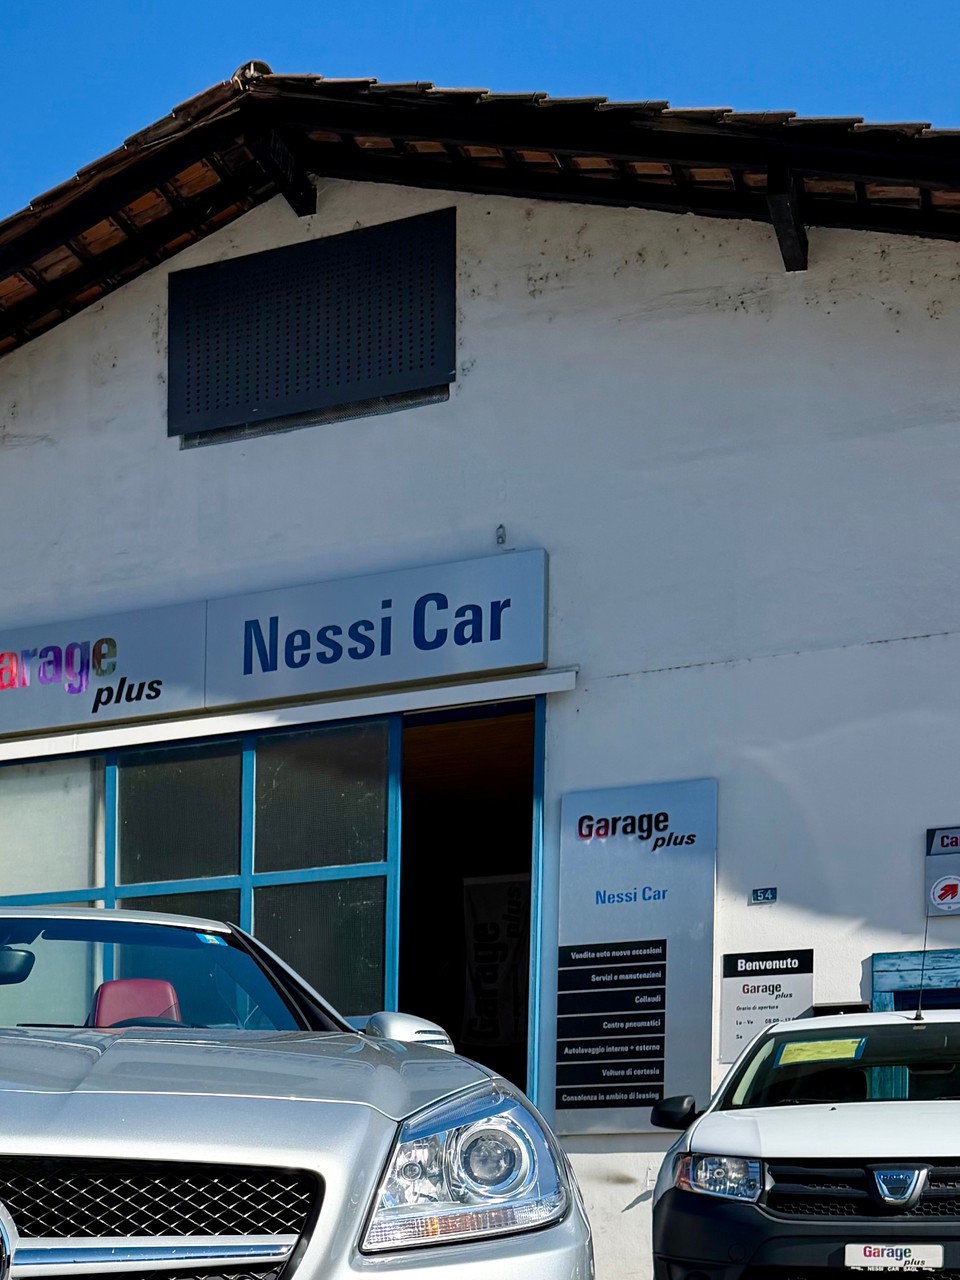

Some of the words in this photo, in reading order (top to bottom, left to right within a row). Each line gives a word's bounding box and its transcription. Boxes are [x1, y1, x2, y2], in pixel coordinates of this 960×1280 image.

[243, 600, 393, 676] Nessi
[412, 592, 512, 651] Car
[91, 675, 163, 713] plus
[577, 811, 670, 841] Garage
[651, 831, 697, 852] plus
[940, 834, 960, 848] Ca
[595, 887, 638, 905] Nessi
[642, 886, 669, 901] Car
[757, 889, 772, 900] 54
[737, 958, 799, 971] Benvenuto
[742, 983, 782, 995] Garage
[775, 992, 793, 1000] plus
[863, 1246, 912, 1261] Garage
[903, 1259, 926, 1267] plus
